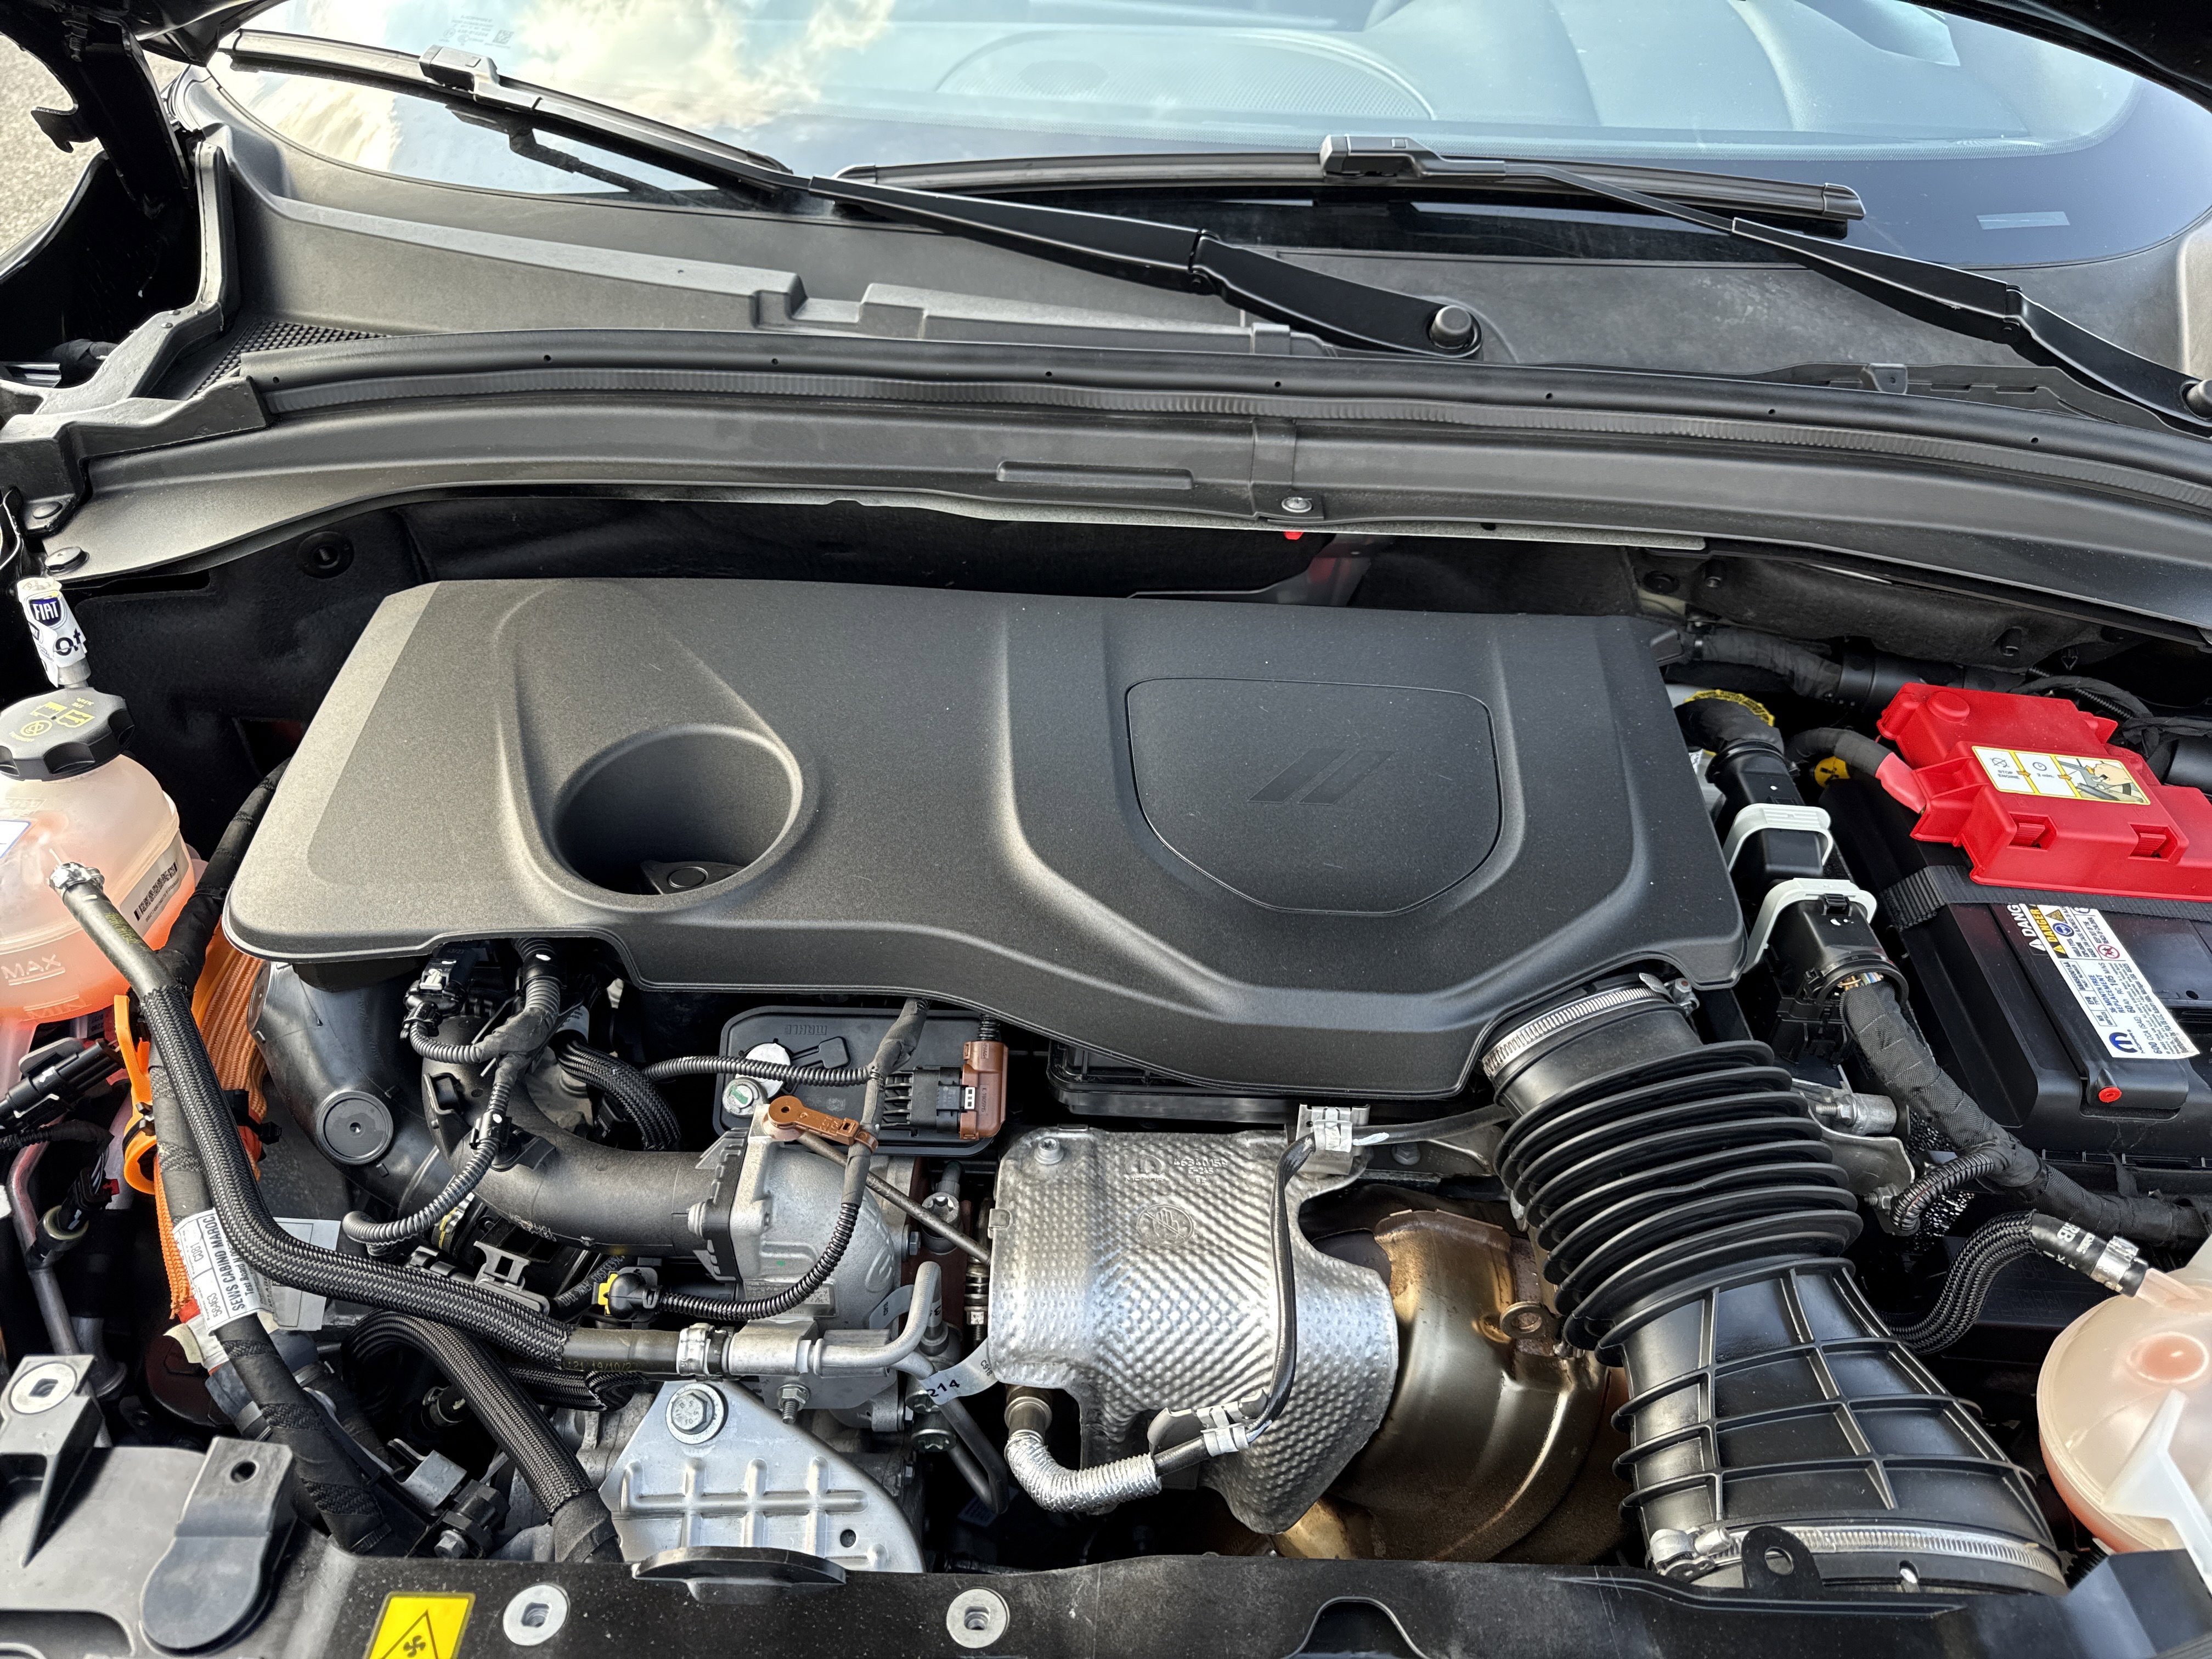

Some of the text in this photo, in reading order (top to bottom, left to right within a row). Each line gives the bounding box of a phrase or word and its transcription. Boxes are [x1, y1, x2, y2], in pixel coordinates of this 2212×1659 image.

[32, 600, 59, 621] FIAT
[2006, 904, 2037, 937] DANG
[2029, 909, 2059, 943] DANGER
[1, 953, 61, 979] MAX
[2087, 974, 2100, 985] FREE
[2104, 975, 2119, 986] 105
[2095, 974, 2125, 1013] REPLACEMENT
[785, 1024, 827, 1036] MAHLE
[2141, 1030, 2154, 1040] CCA
[2147, 1042, 2163, 1053] 600
[202, 1216, 246, 1311] SEWS CABIND MAROC
[235, 1264, 250, 1282] Board
[242, 1282, 254, 1296] Test
[927, 1379, 961, 1397] 214
